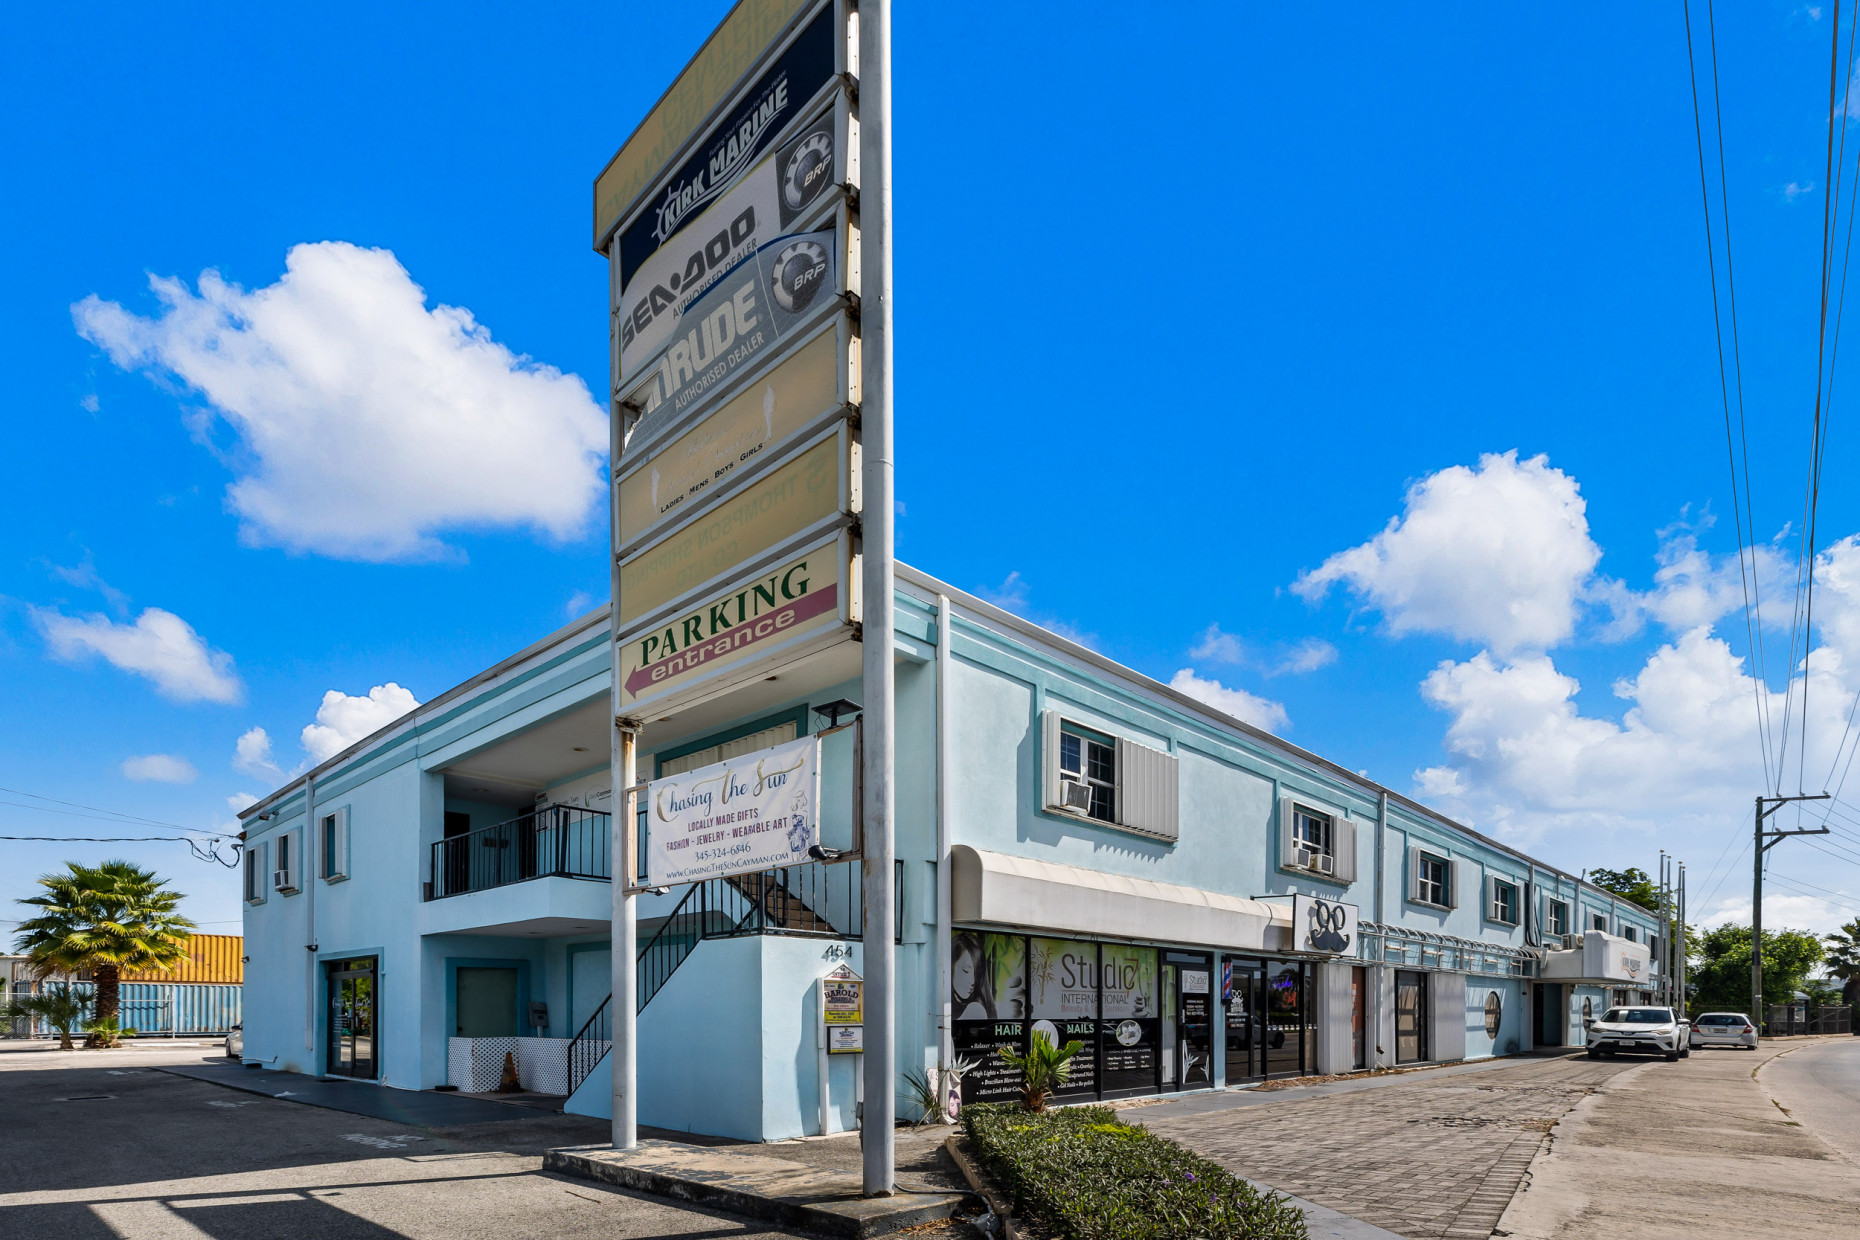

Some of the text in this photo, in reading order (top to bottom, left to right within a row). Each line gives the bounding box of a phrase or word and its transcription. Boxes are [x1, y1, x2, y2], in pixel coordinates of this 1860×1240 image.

[664, 79, 788, 232] KIRK MARINE
[804, 154, 831, 188] BRP
[794, 263, 825, 291] BRP
[675, 331, 765, 411] AUTHORISED DEALER
[640, 561, 811, 669] PARKING
[651, 609, 796, 681] entrance
[657, 782, 713, 823] Chasing
[753, 757, 804, 798] Sun
[666, 838, 690, 852] FASHION
[696, 830, 725, 846] JEWELRY
[732, 820, 770, 839] WEARABLE
[772, 817, 788, 830] ART
[688, 808, 759, 833] LOCALLY MADE GIFTS
[695, 840, 752, 863] 345-324-6846
[825, 944, 853, 958] 454
[824, 989, 859, 999] HAROLD
[994, 1024, 1022, 1036] HAIR
[1066, 1023, 1095, 1034] NAILS
